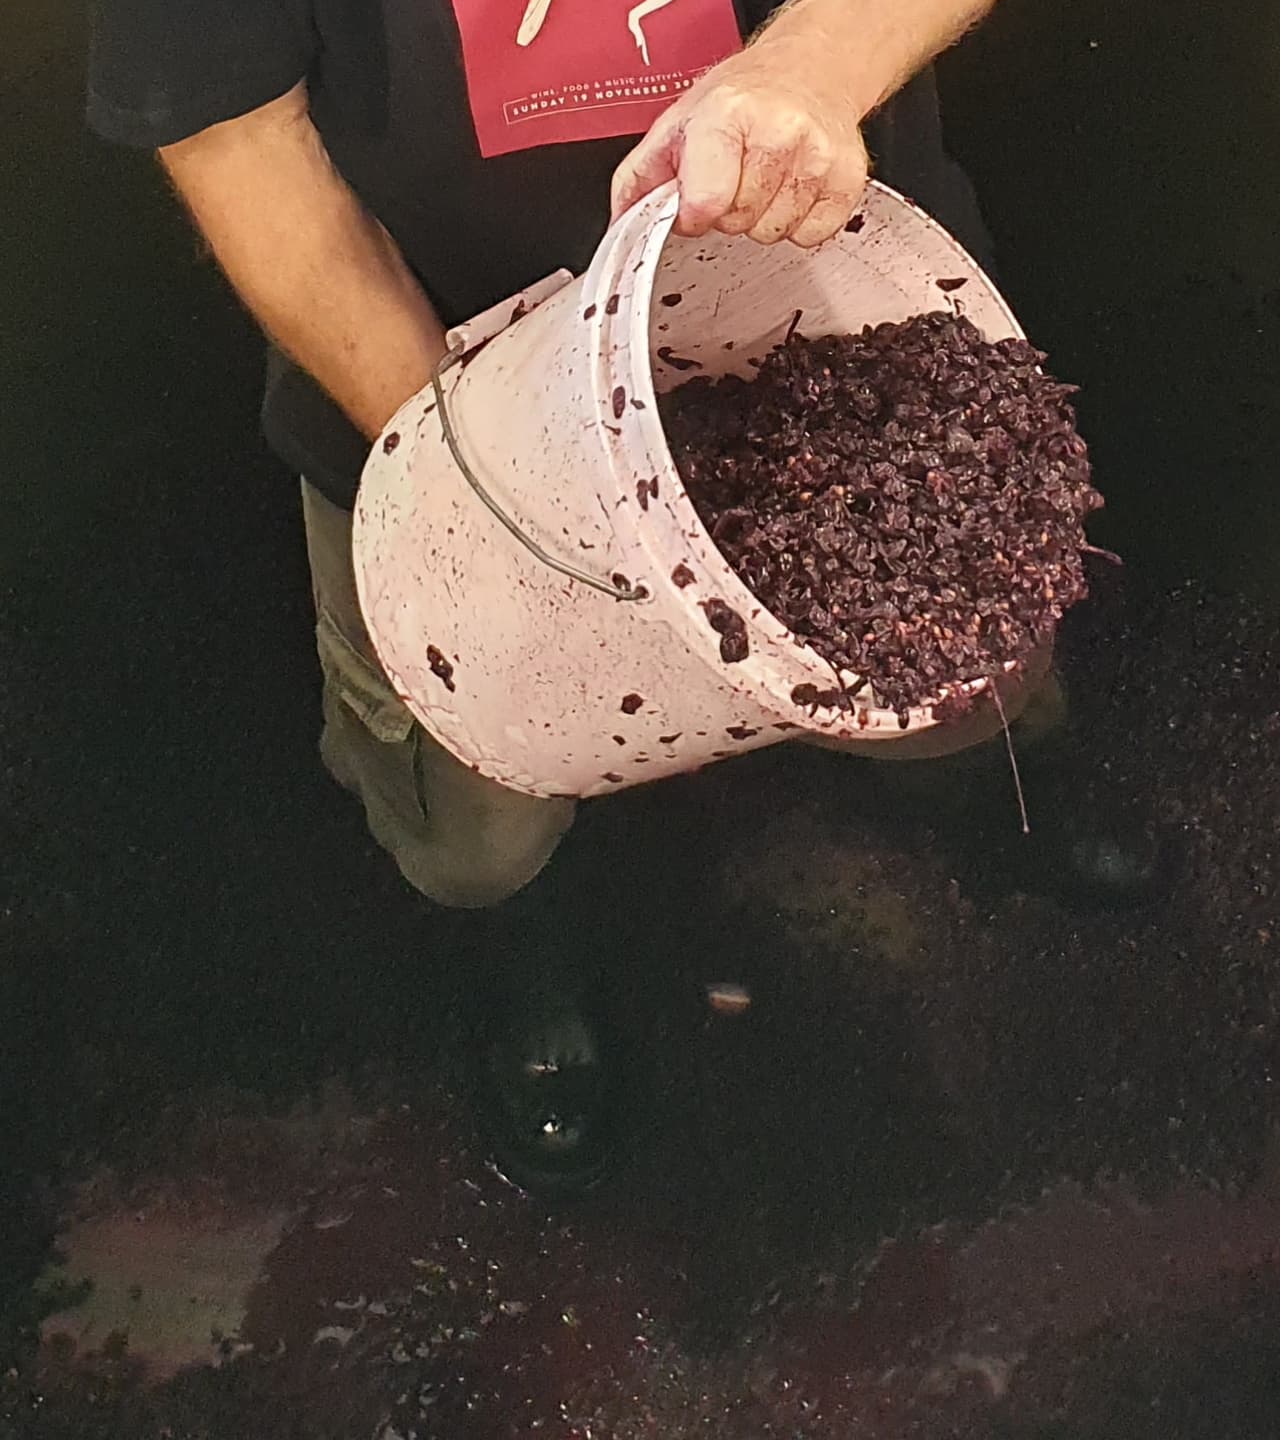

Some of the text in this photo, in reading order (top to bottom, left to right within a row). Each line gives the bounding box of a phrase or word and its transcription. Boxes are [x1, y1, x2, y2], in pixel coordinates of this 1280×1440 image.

[563, 83, 590, 93] FOOD
[594, 80, 601, 89] &
[605, 77, 635, 87] MUSIC
[639, 71, 683, 84] FESTIVAL
[513, 97, 566, 116] SUNDAY
[574, 93, 588, 103] 19
[595, 84, 668, 100] NOVEMBER
